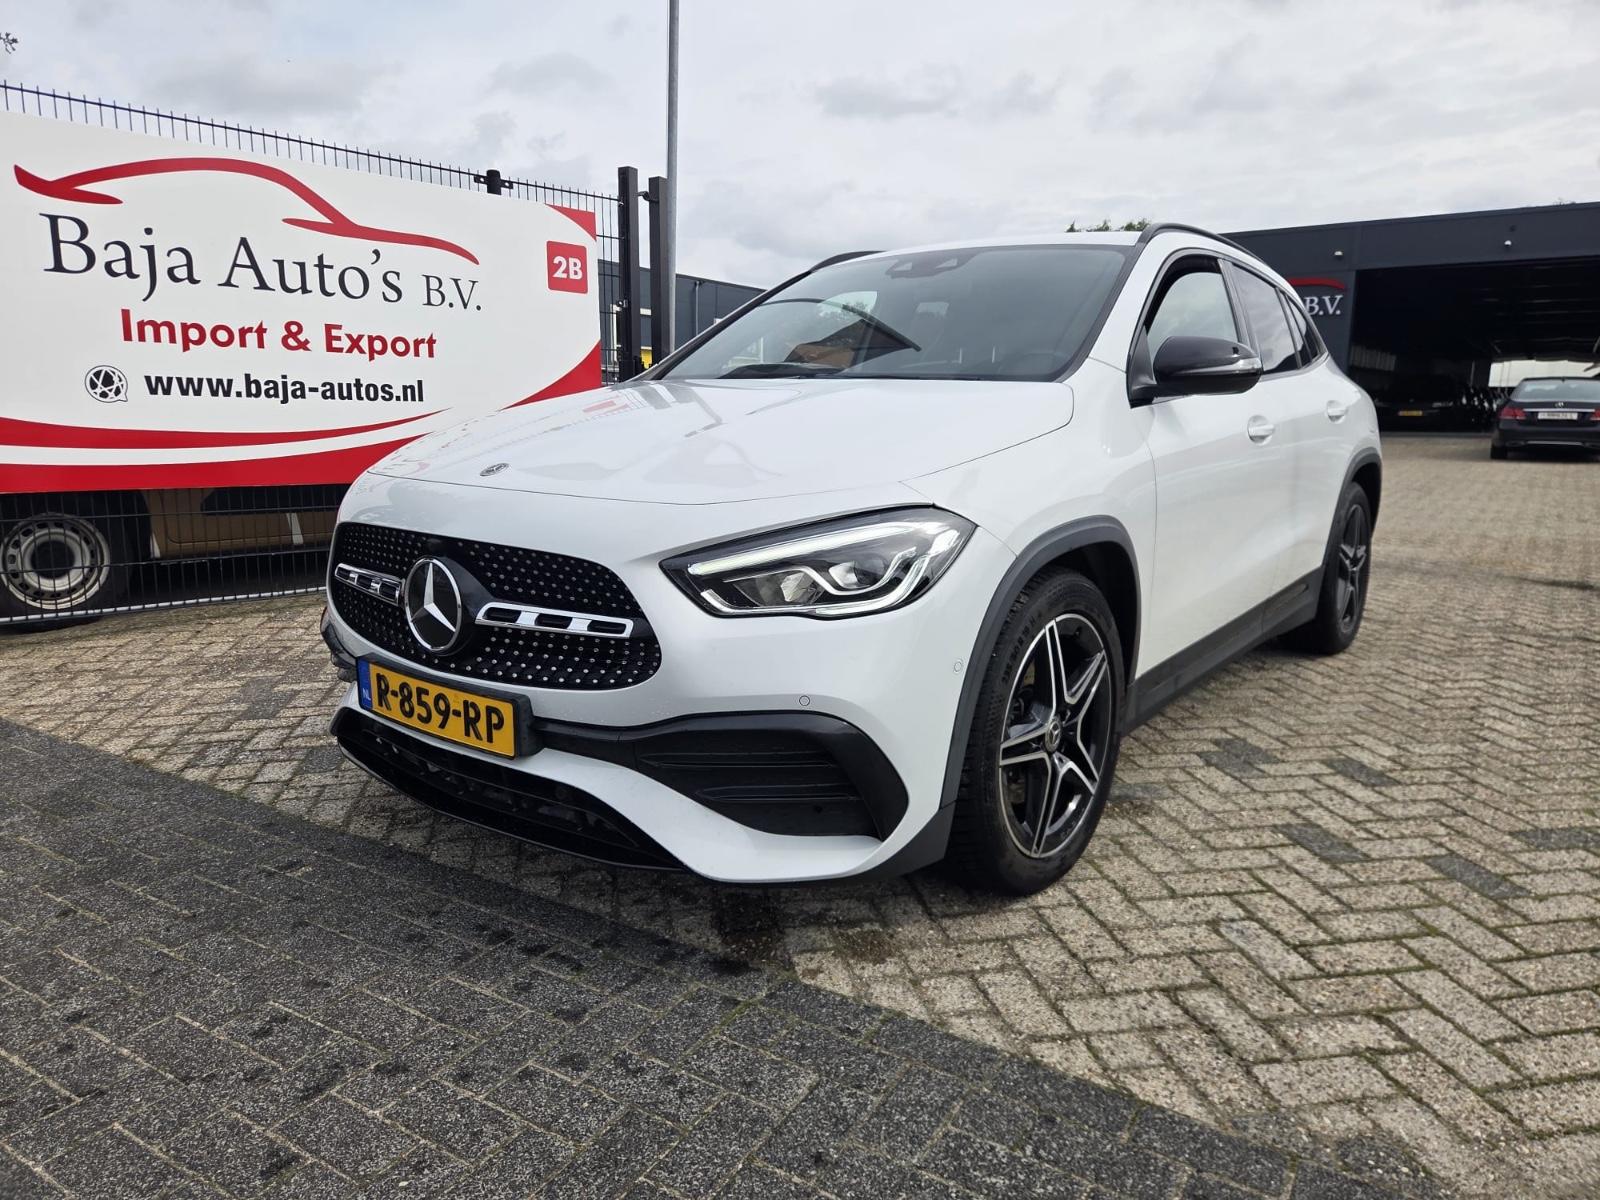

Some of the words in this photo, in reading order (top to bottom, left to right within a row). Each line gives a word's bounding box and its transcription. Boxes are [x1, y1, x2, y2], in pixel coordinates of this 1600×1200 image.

[39, 213, 202, 303] Baja
[218, 237, 403, 303] Auto's
[422, 275, 482, 311] B.V.
[553, 255, 583, 280] 2B
[1304, 295, 1343, 315] B.V.
[120, 309, 267, 352] Import
[282, 321, 312, 351] &
[325, 324, 437, 361] Export
[144, 373, 424, 405] www.baja-autos.nl
[362, 687, 372, 701] NL
[375, 672, 506, 744] R-859-RP
